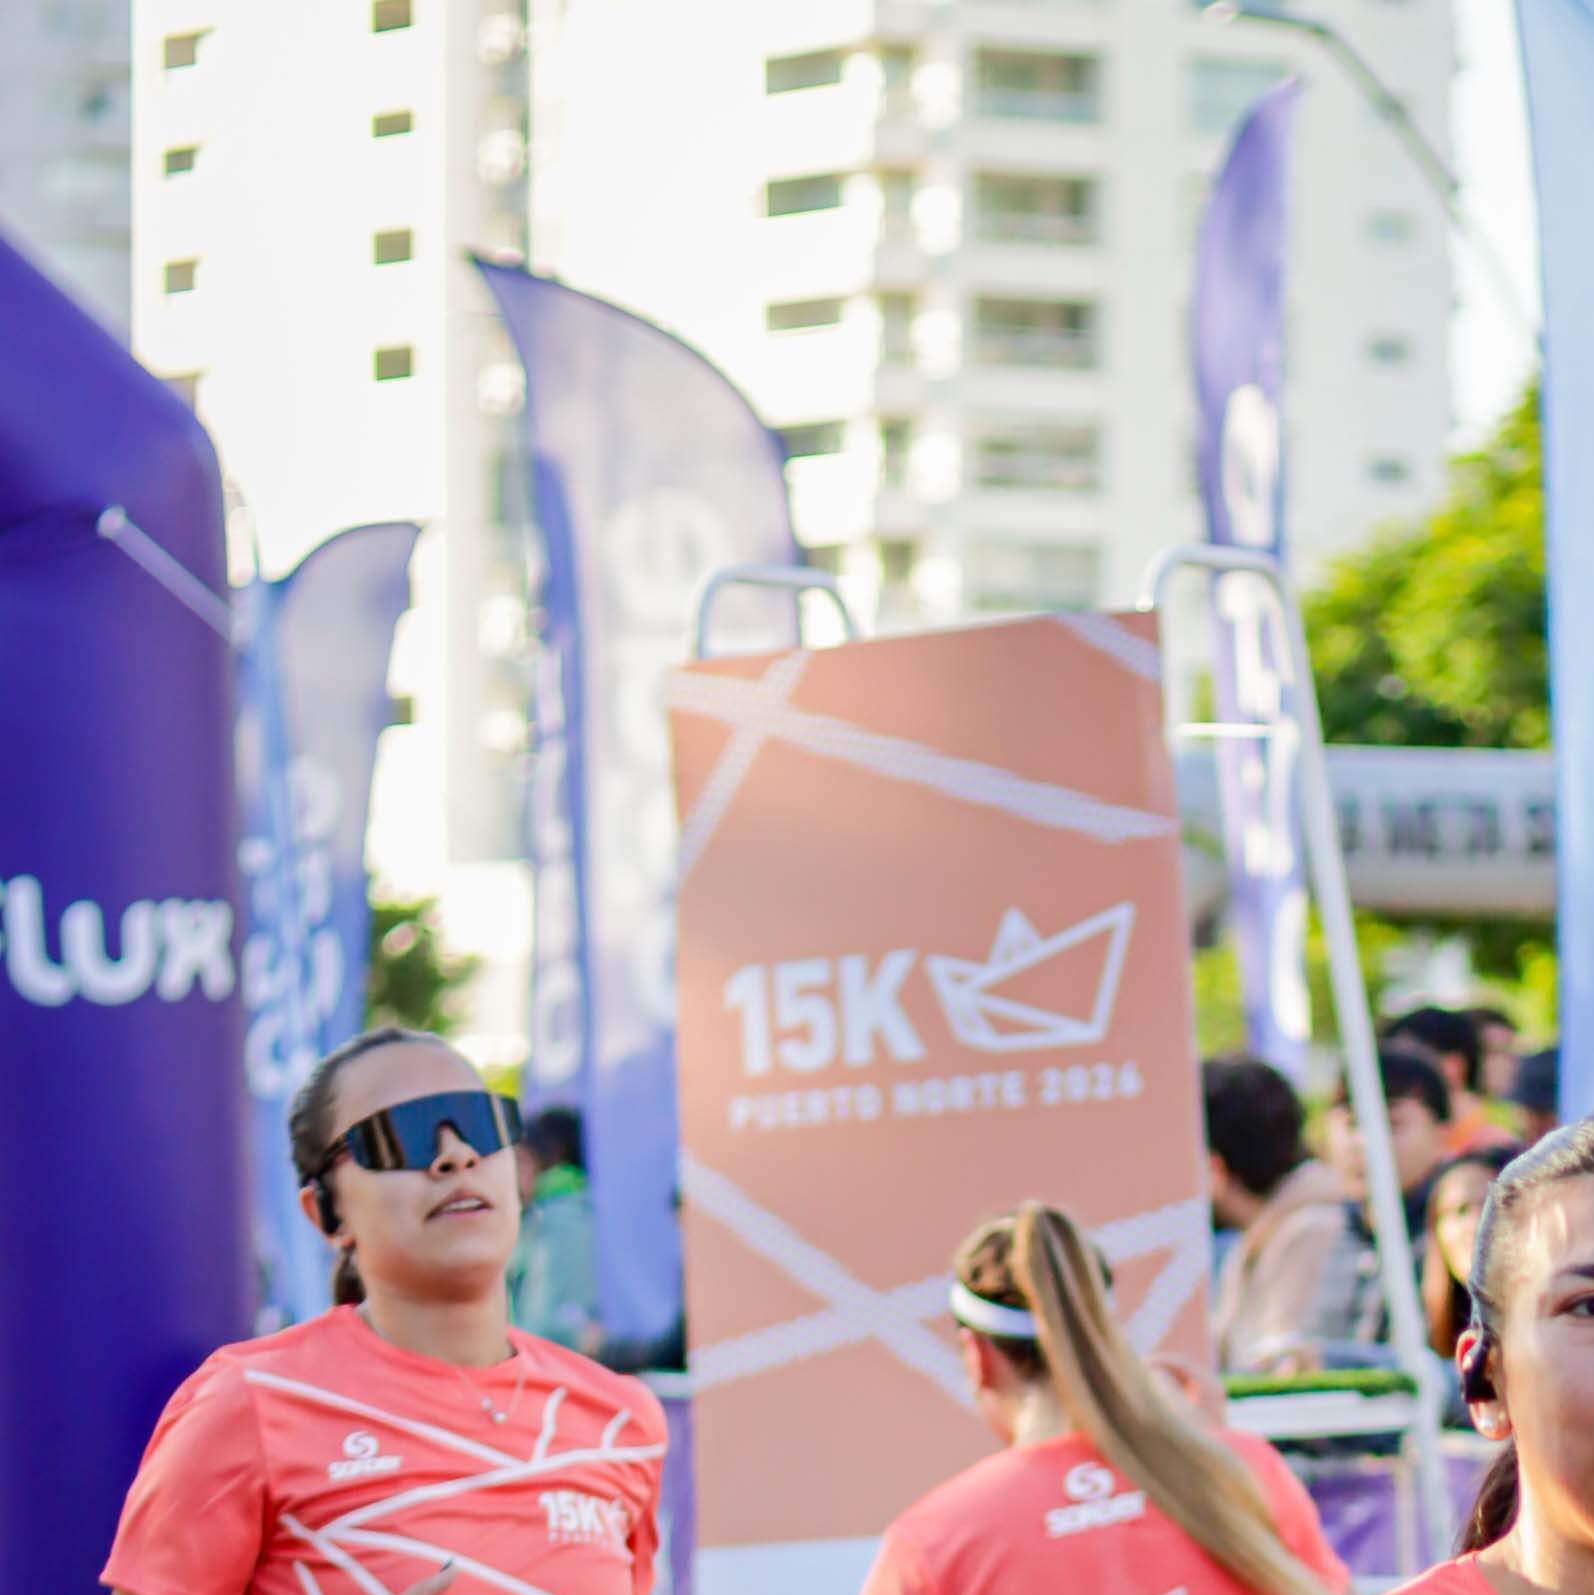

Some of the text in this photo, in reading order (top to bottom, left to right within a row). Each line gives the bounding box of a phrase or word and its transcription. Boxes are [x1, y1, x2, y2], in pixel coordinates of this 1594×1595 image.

[0, 873, 236, 1007] lux
[722, 948, 926, 1078] 15K
[729, 1083, 882, 1132] PUERTO
[893, 1069, 1026, 1118] NORTE
